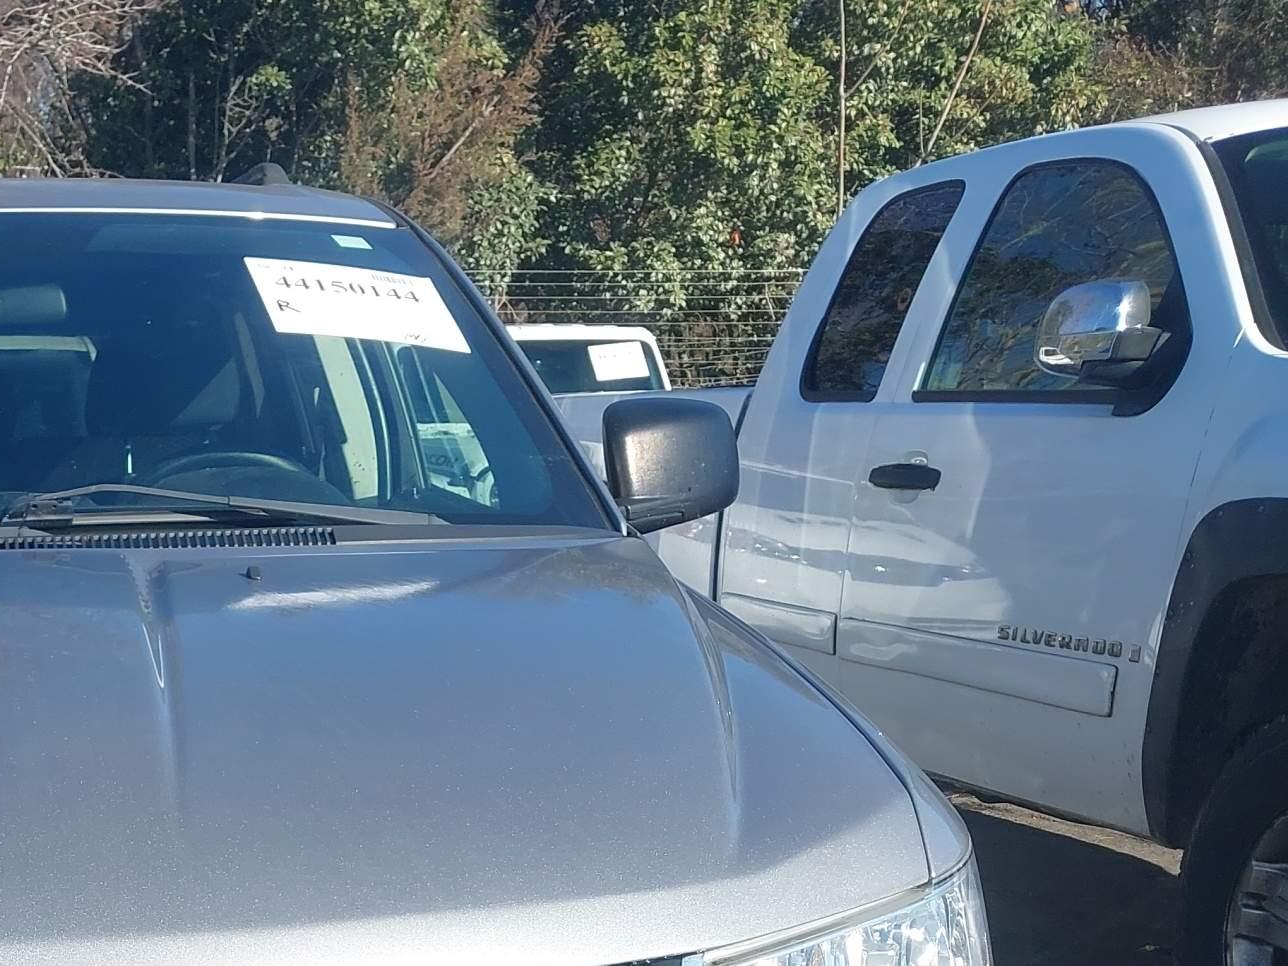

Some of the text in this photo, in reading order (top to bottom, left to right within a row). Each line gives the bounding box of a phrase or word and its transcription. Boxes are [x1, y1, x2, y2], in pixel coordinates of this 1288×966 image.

[276, 276, 419, 302] 44150144
[277, 299, 301, 312] R
[997, 625, 1122, 657] SILVERADO
